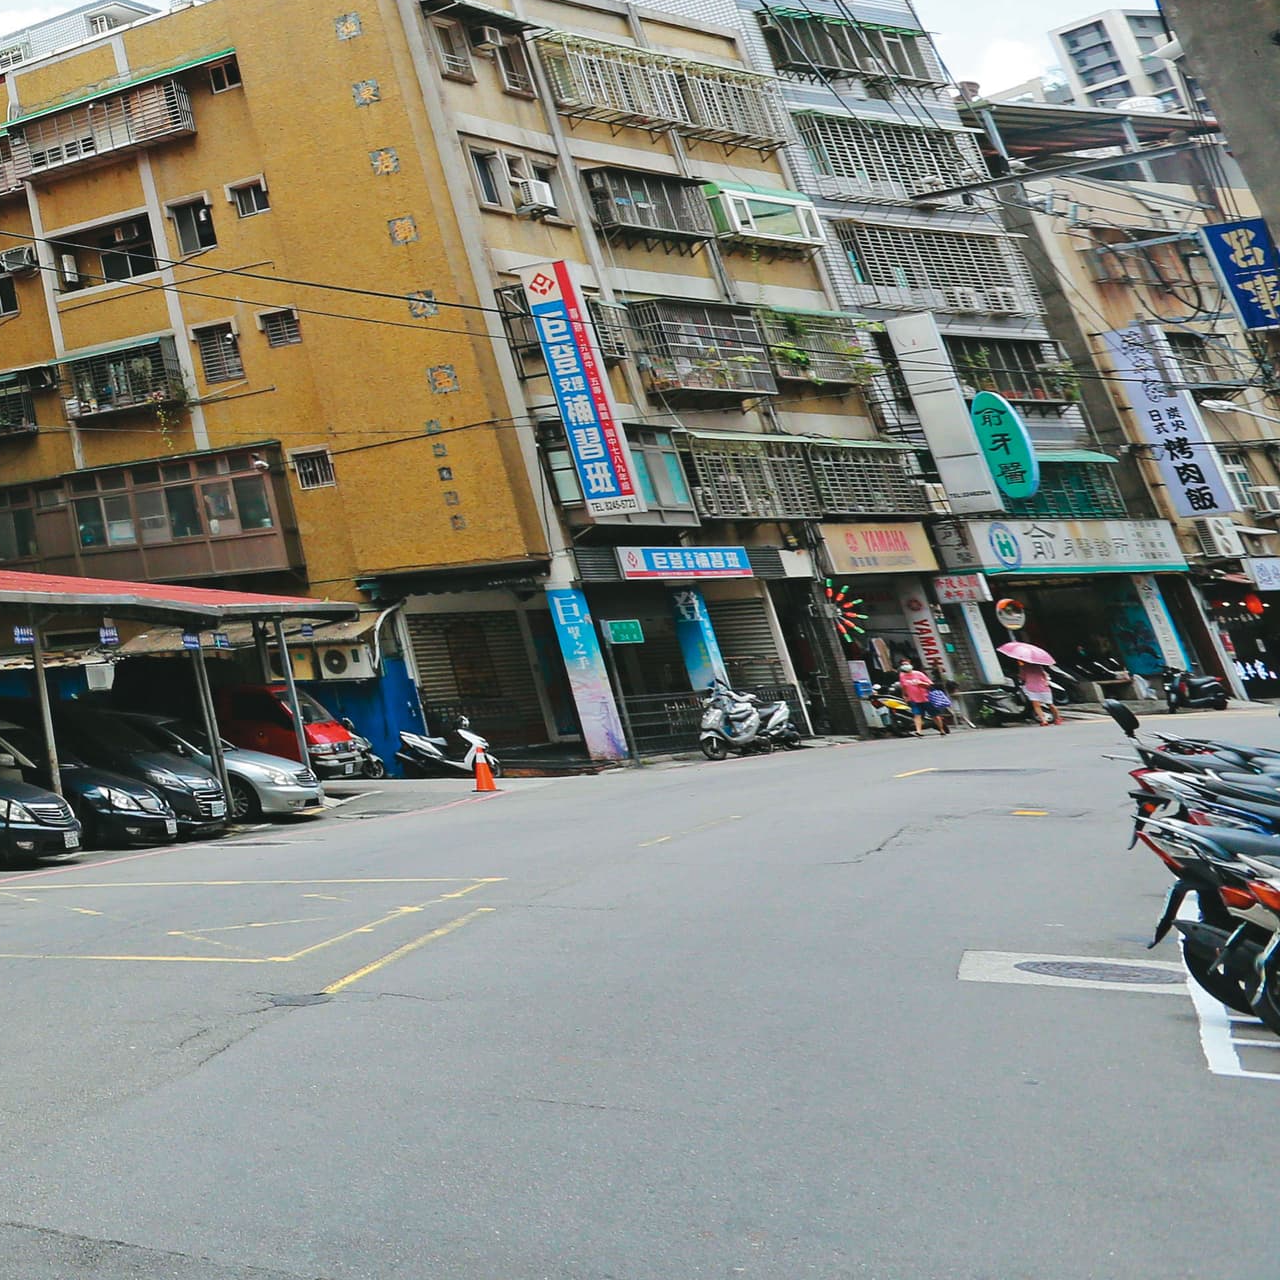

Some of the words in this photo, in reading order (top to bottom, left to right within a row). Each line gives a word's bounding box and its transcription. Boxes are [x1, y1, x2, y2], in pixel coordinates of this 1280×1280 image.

[1148, 409, 1170, 435] 日式
[1165, 406, 1188, 433] 炭火
[974, 407, 1027, 485] 俞牙醫
[1163, 436, 1219, 511] 烤肉飯
[861, 530, 911, 552] YAMAHA
